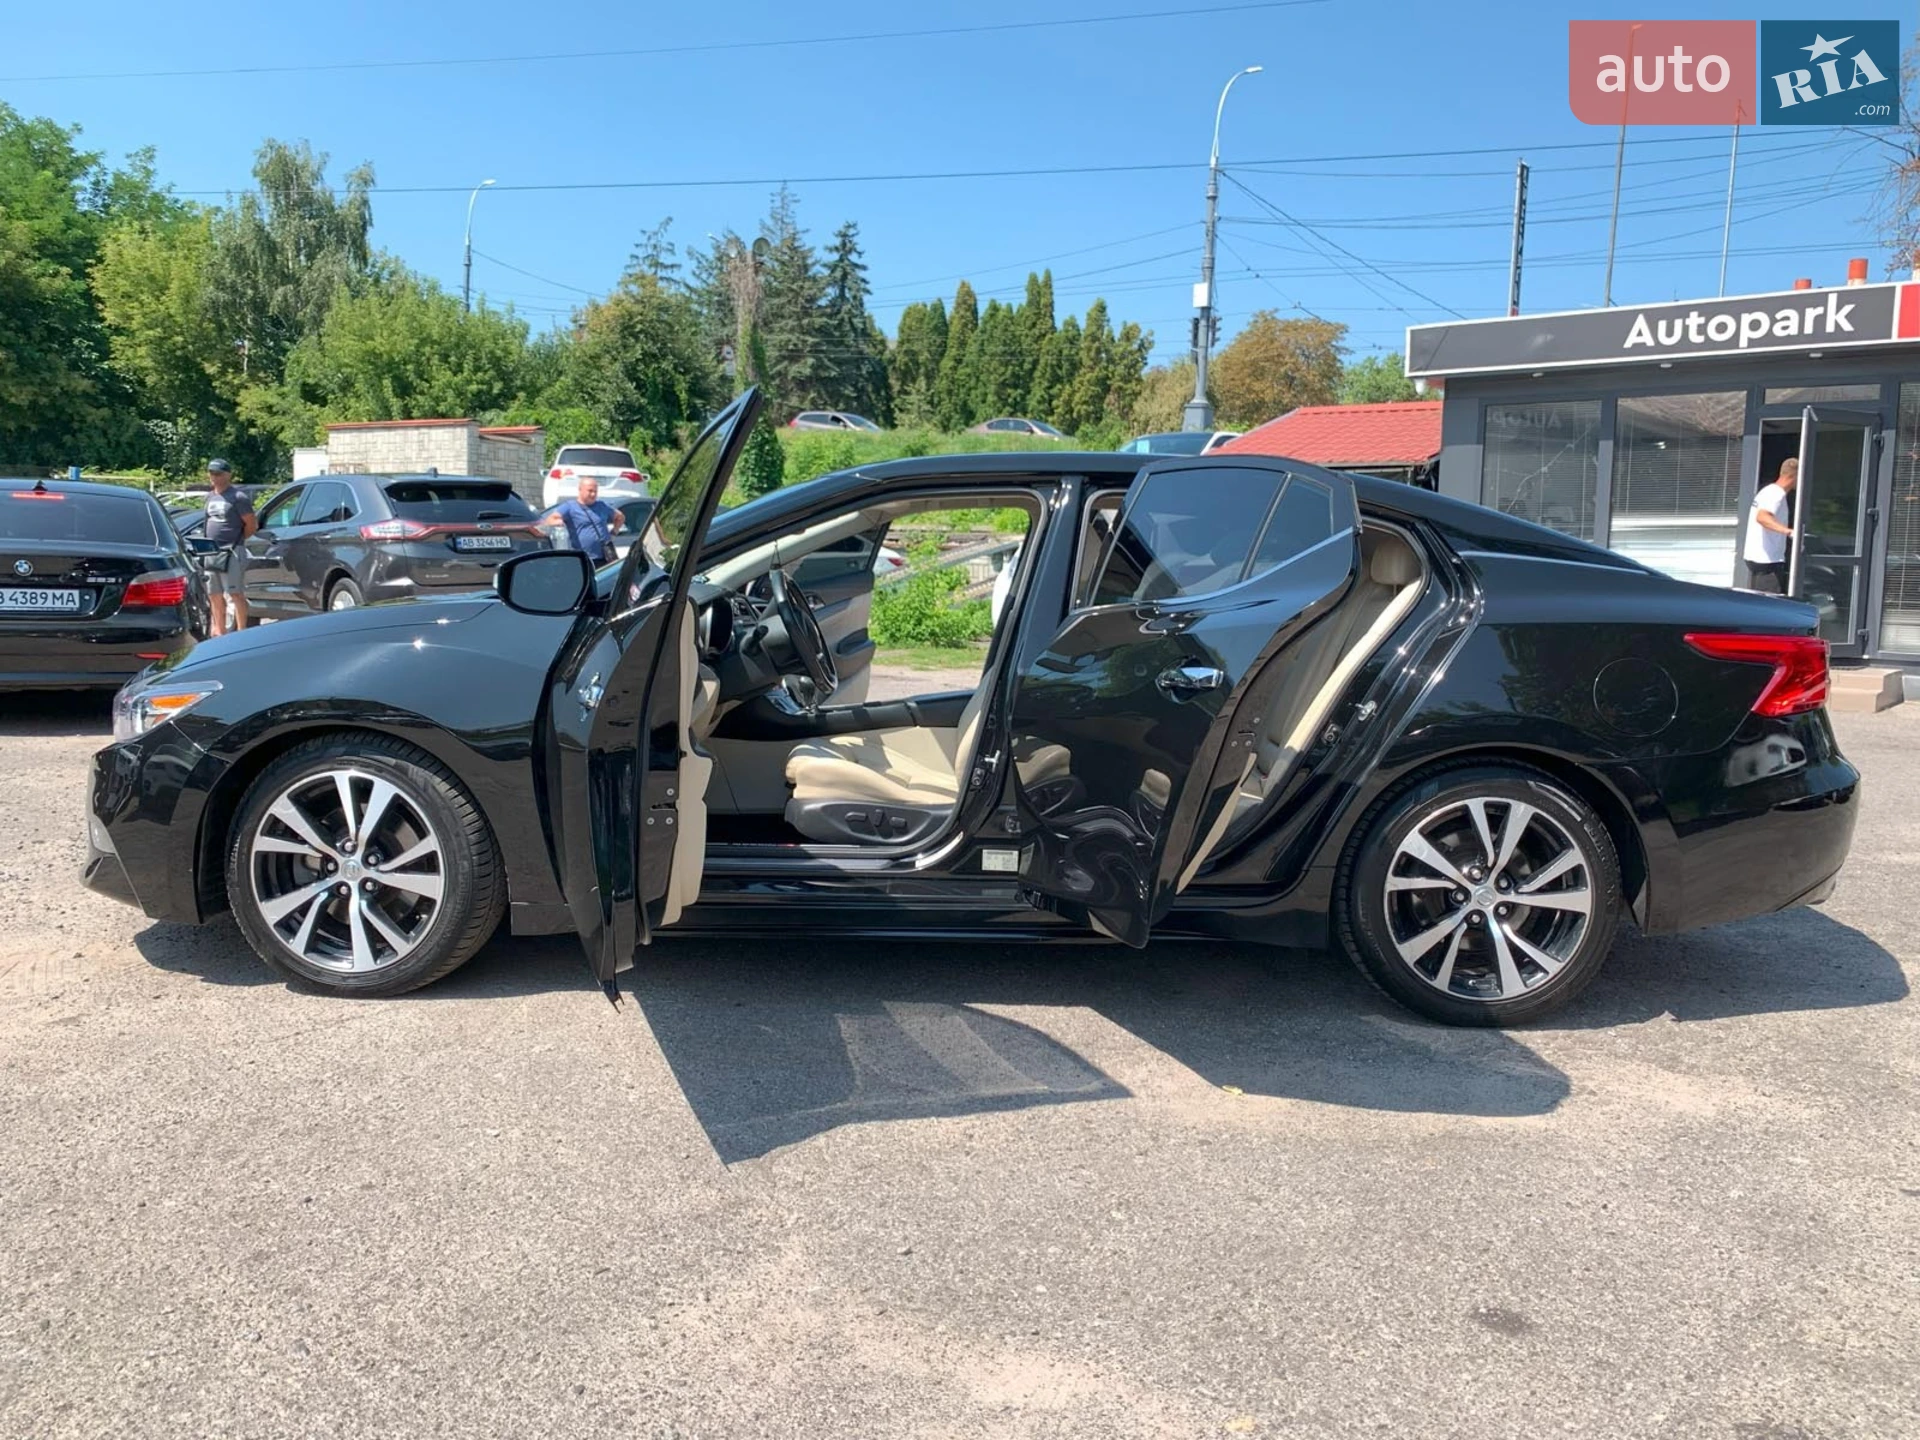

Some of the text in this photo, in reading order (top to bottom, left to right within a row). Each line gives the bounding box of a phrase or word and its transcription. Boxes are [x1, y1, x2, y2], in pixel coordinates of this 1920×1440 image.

[1623, 293, 1855, 348] Autopark
[9, 591, 48, 605] 4389
[52, 592, 76, 605] MA
